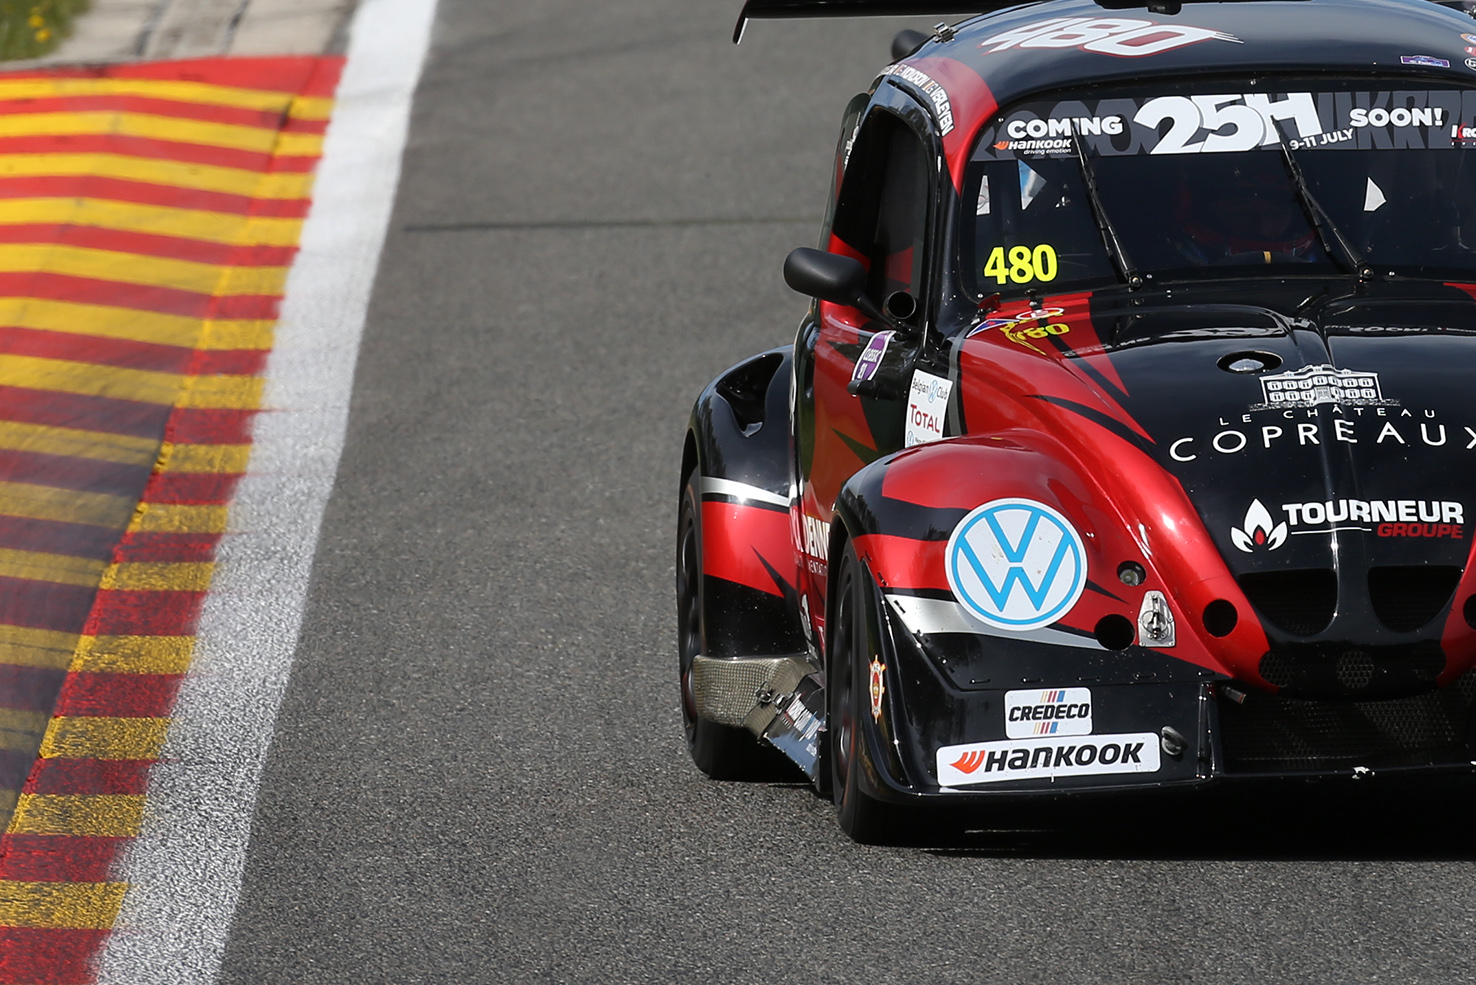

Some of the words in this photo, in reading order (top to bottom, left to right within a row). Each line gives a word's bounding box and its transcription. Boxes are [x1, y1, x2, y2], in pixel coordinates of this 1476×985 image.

[977, 16, 1244, 58] 480
[1007, 115, 1123, 139] COMING
[1132, 91, 1323, 155] 25H
[1349, 107, 1443, 128] SOON!
[1008, 138, 1072, 150] HANKOOK
[1290, 135, 1318, 151] 9-11
[1320, 127, 1354, 147] JULY
[984, 244, 1058, 285] 480
[937, 386, 948, 400] Club
[910, 403, 940, 434] TOTAL
[1219, 413, 1252, 427] LE
[1282, 403, 1436, 419] CHÂTEAU
[1282, 498, 1464, 526] TOURNEUR
[1376, 522, 1464, 539] GROUPE
[1008, 703, 1090, 722] CREDECO
[984, 742, 1144, 773] HANKOOK
